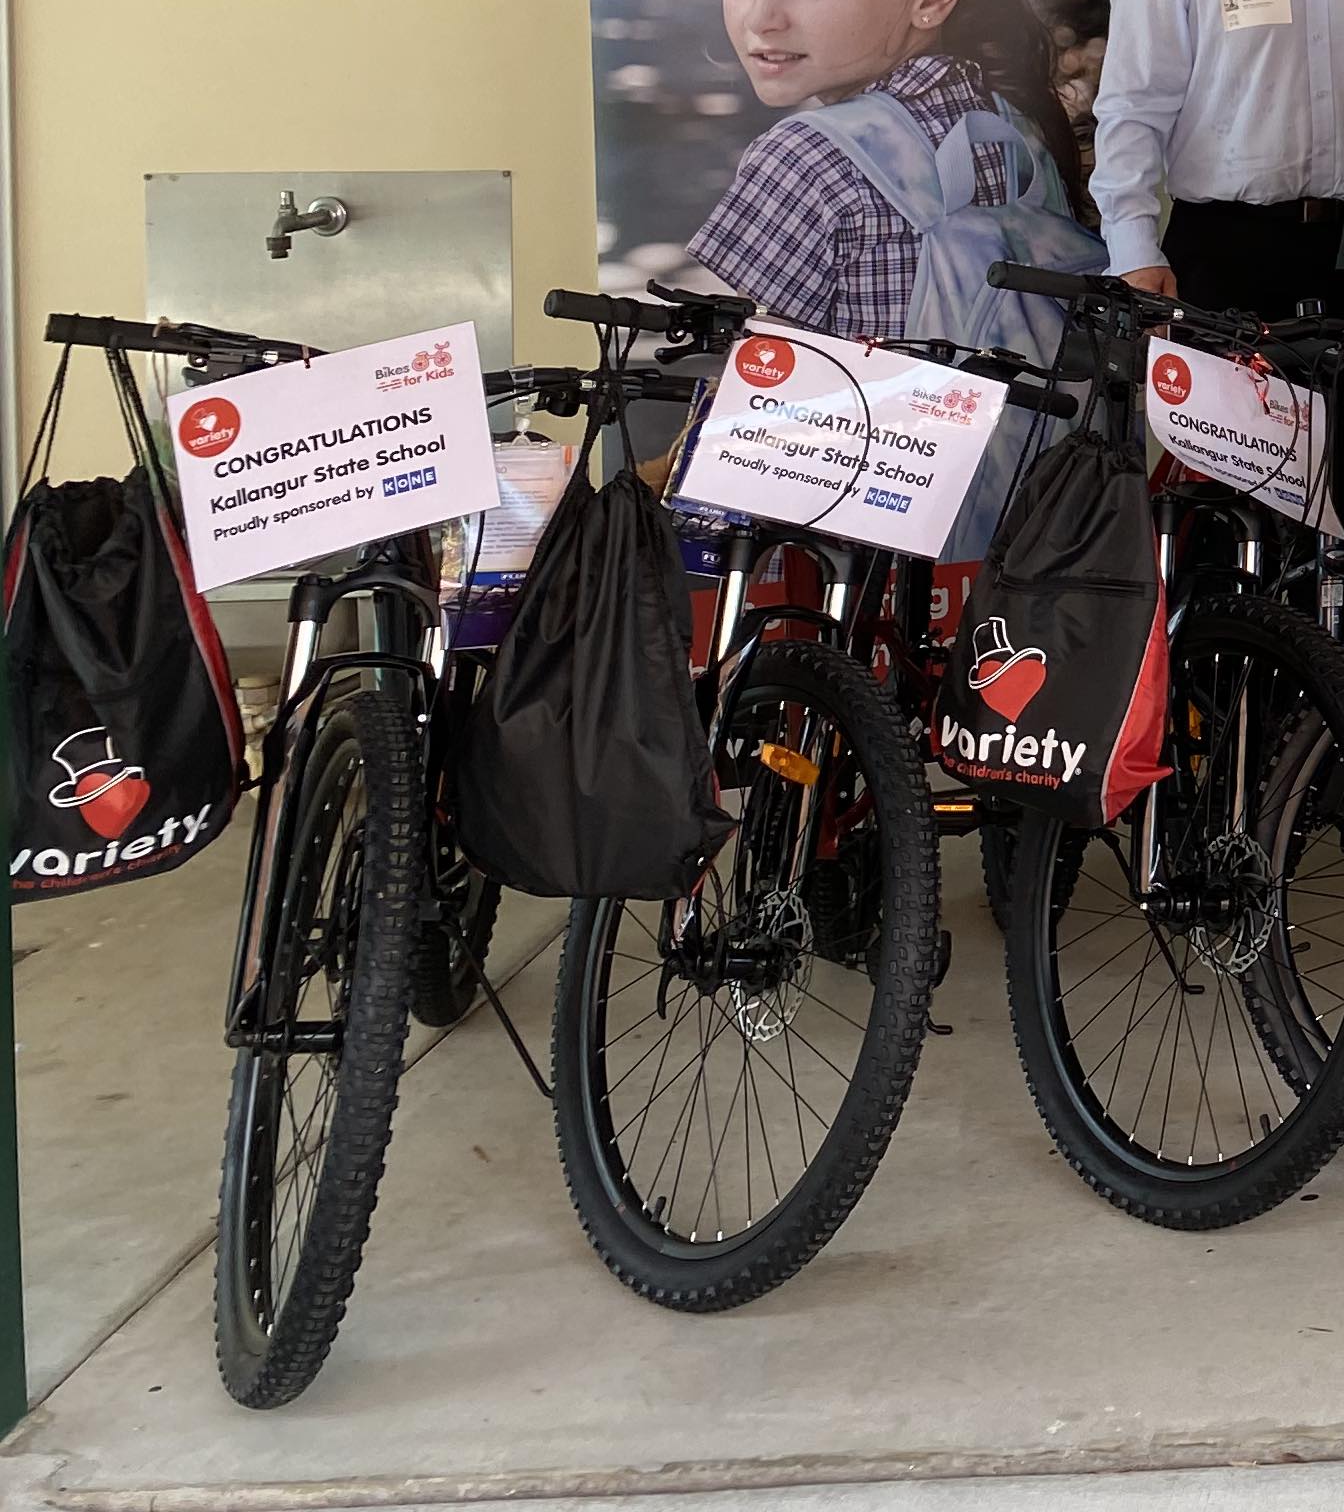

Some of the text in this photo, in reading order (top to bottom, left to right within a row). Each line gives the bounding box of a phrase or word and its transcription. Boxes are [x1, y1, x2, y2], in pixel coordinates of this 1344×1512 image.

[375, 363, 409, 380] Bikes
[403, 366, 454, 387] for Kids
[742, 362, 784, 381] variety
[912, 387, 941, 403] Bikes
[188, 426, 234, 448] variety
[749, 395, 937, 457] CONGRATULATIONS
[929, 405, 972, 425] for Kids
[1169, 411, 1296, 462] CONGRATULATIONS
[214, 407, 432, 478] CONGRATULATIONS
[729, 422, 933, 488] Kallangur State School
[211, 436, 446, 514] Kallangur State School
[719, 450, 912, 513] Proudly sponsored by KONE
[1231, 455, 1263, 475] State
[1267, 466, 1305, 488] School
[214, 467, 436, 540] Proudly sponsored by KONE
[941, 715, 1087, 783] variety
[1016, 770, 1061, 791] charity
[9, 803, 212, 876] variety
